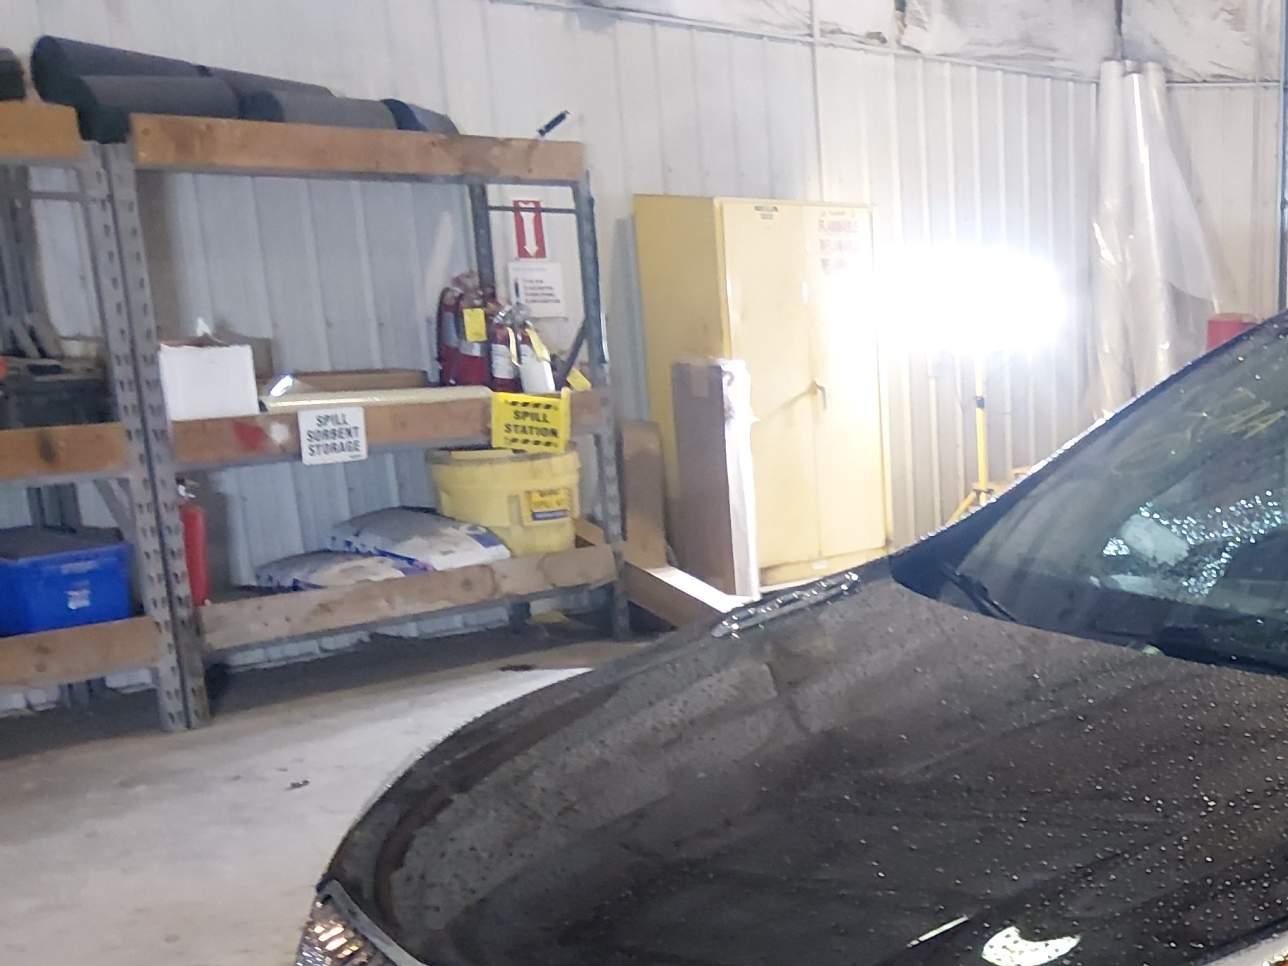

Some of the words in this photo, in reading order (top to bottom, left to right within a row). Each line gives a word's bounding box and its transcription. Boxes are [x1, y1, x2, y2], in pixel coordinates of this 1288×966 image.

[315, 413, 349, 428] SPILL
[512, 409, 550, 424] SPILL
[306, 425, 360, 443] SORBENT
[503, 423, 560, 439] STATION
[307, 440, 361, 457] STORAGE
